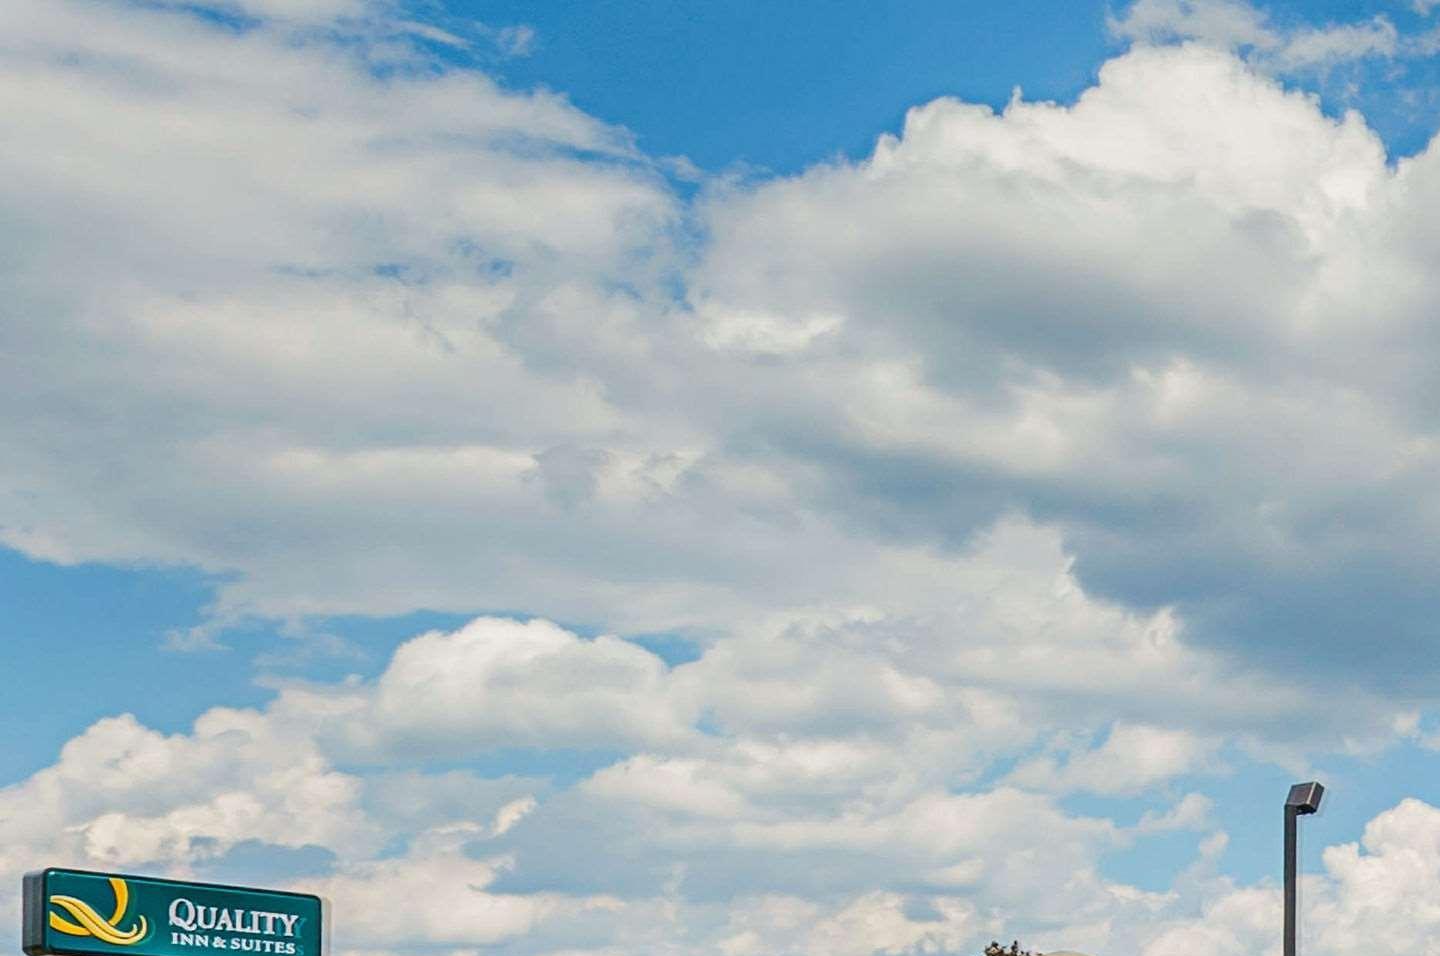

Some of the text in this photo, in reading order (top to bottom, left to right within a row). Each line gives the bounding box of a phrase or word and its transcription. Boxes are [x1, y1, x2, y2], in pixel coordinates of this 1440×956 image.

[168, 898, 299, 937] QUALITY
[171, 932, 296, 955] INN & SUITES
